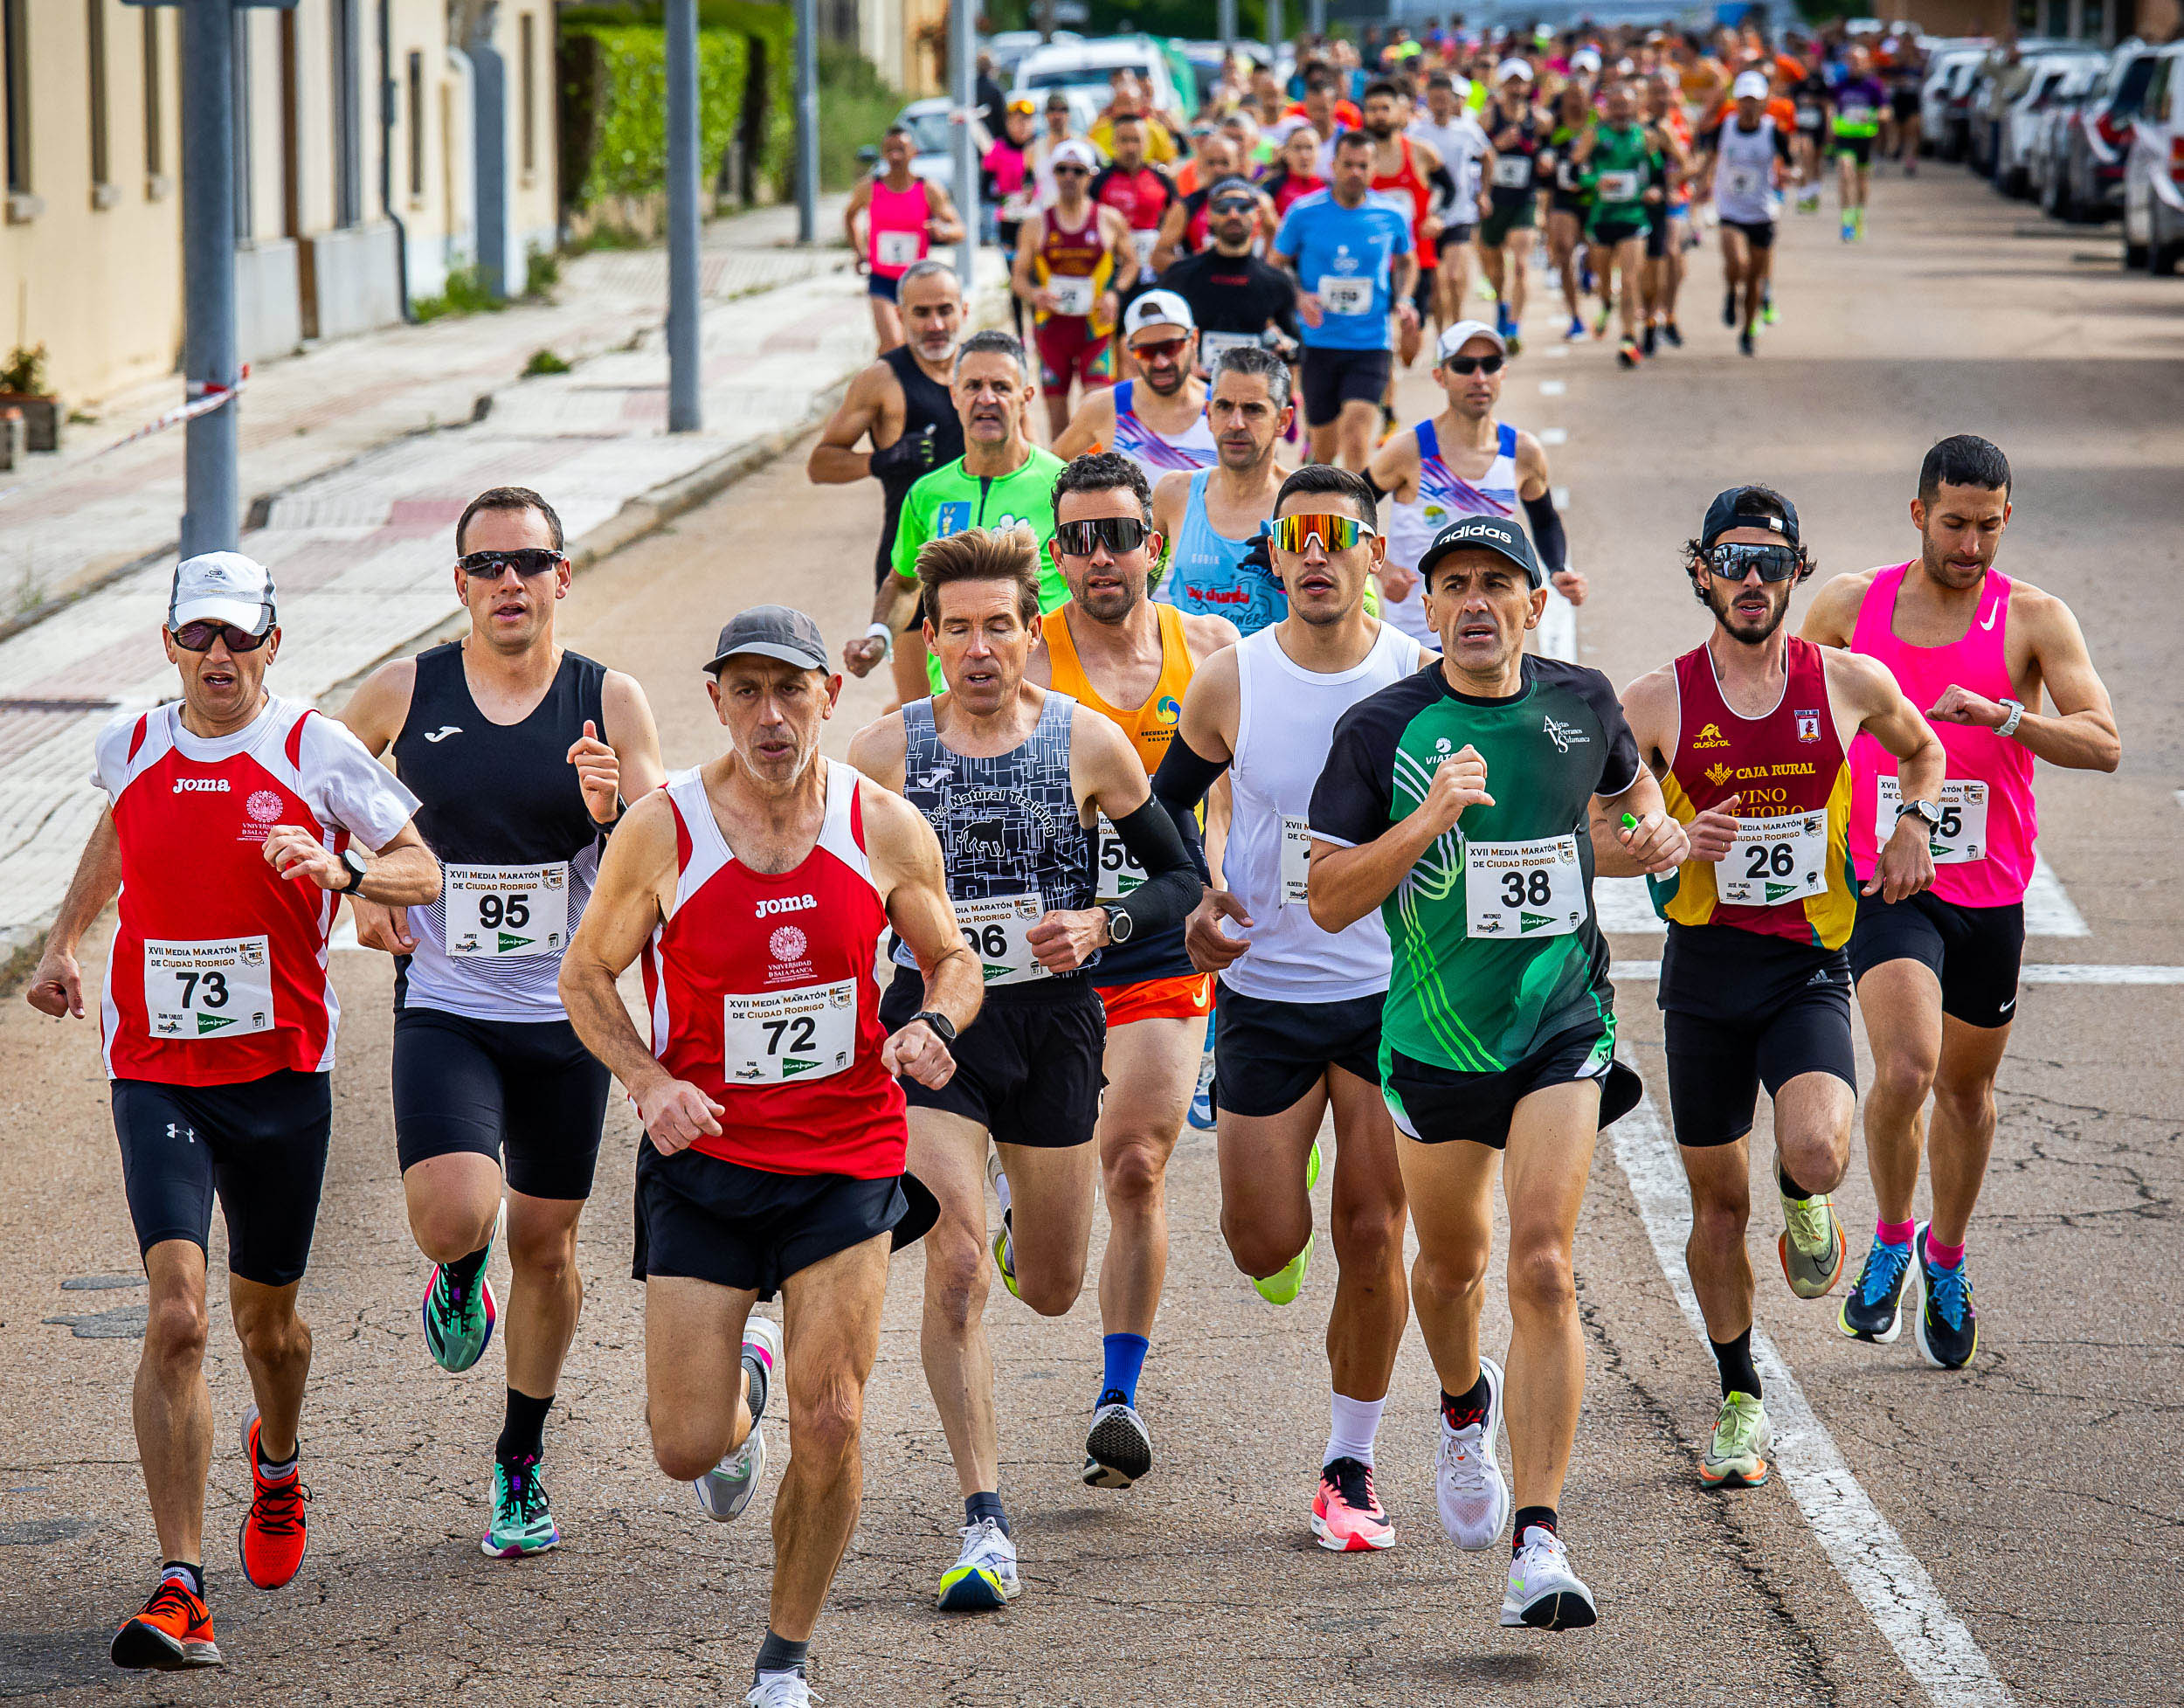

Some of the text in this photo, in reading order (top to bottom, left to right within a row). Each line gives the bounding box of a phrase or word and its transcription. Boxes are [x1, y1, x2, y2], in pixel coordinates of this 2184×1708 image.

[1439, 525, 1512, 544] adidas
[1737, 763, 1816, 779] CAJA RURAL
[1734, 788, 1787, 805] VINO
[949, 789, 1005, 808] Natural
[1010, 791, 1055, 838] Training
[1747, 806, 1805, 818] TORO
[1763, 819, 1801, 831] MARATÓN
[1765, 832, 1800, 841] RODRIGO
[1521, 844, 1557, 855] MARATÓN
[1523, 857, 1555, 867] RODRIGO
[1745, 843, 1794, 879] 26
[1501, 869, 1552, 908] 38
[479, 894, 529, 929] 95
[971, 902, 1013, 912] MARATÓN
[974, 913, 1011, 923] RODRIGO
[149, 946, 163, 955] XVII
[165, 947, 190, 956] MEDIA
[193, 945, 237, 956] MARATÓN
[195, 958, 235, 968] RODRIGO
[176, 972, 229, 1008] 73
[752, 999, 780, 1007] MEDIA
[783, 991, 826, 1003] MARATÓN
[747, 1009, 782, 1019] CIUDAD
[784, 1003, 825, 1015] RODRIGO
[763, 1017, 816, 1055] 72
